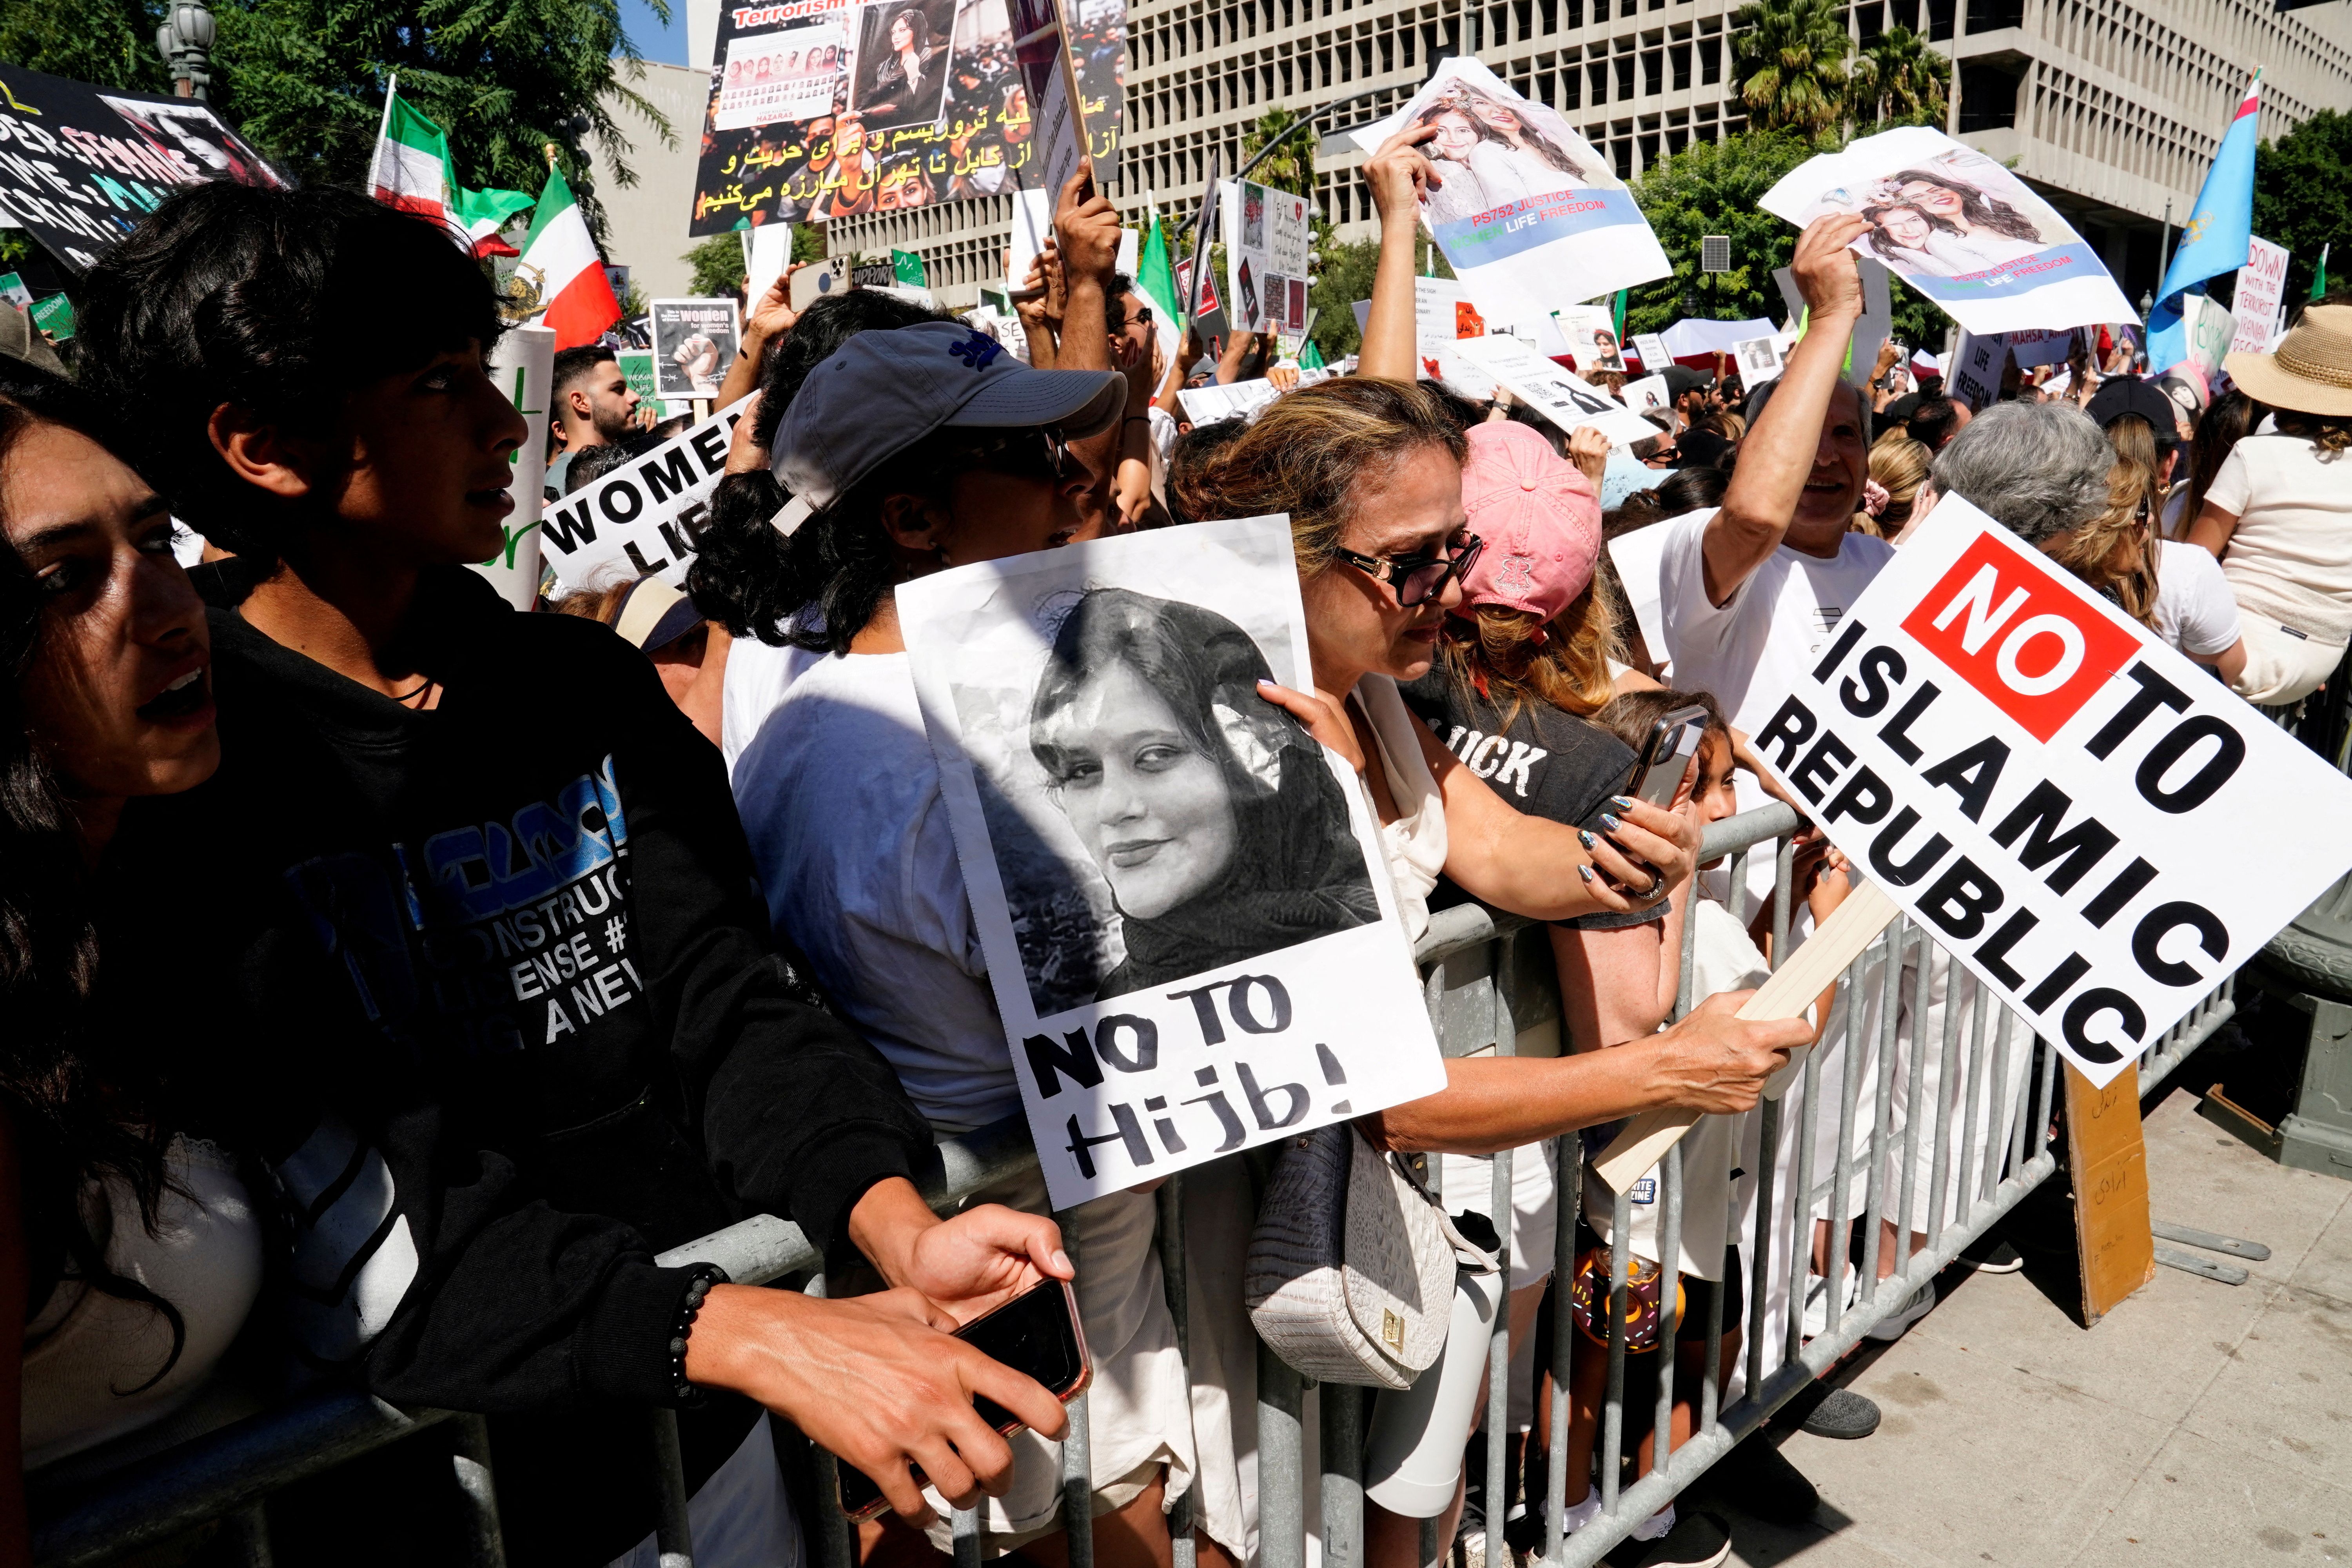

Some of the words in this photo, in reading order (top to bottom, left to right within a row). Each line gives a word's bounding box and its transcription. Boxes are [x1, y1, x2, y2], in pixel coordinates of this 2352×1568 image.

[734, 0, 846, 28] Terrorism
[756, 111, 793, 122] HAZARAS
[892, 109, 987, 152] تروریسم
[996, 102, 1031, 131] لیه
[60, 126, 214, 184] FEMALE
[744, 144, 803, 167] حریت
[811, 132, 862, 160] برای
[868, 133, 885, 151] و
[1008, 141, 1032, 169] از
[721, 154, 737, 174] و
[856, 156, 920, 190] تهران
[929, 152, 947, 173] تا
[954, 145, 1001, 176] کابل
[780, 170, 849, 201] مبارزه
[1472, 204, 1514, 228] PS752
[1517, 189, 1575, 212] JUSTICE
[1448, 224, 1504, 250] WOMEN
[1505, 212, 1537, 234] LIFE
[1539, 200, 1606, 221] FREEDOM
[1951, 271, 1988, 282] PS752
[1989, 254, 2040, 276] JUSTICE
[1984, 274, 2014, 287] LIFE
[2012, 256, 2073, 278] FREEDOM
[2247, 243, 2286, 281] DOWN
[2245, 274, 2263, 291] WITH
[2266, 281, 2276, 295] THE
[34, 296, 65, 323] FREEDOM
[680, 310, 729, 322] women
[2240, 290, 2274, 316] TERRORIST
[2239, 315, 2269, 343] IRANIAN
[1974, 345, 1990, 372] LIFE
[1956, 370, 1992, 408] FREEDOM
[623, 501, 713, 577] LIF
[1931, 563, 2086, 696] NO
[2083, 660, 2246, 815] TO
[1427, 718, 1548, 797] UCK
[1811, 619, 2230, 988] ISLAMIC
[1754, 693, 2147, 1065] REPUBLIC
[1022, 1013, 1158, 1100] NO
[1166, 973, 1293, 1047] TO
[1063, 1042, 1352, 1180] Hijb!
